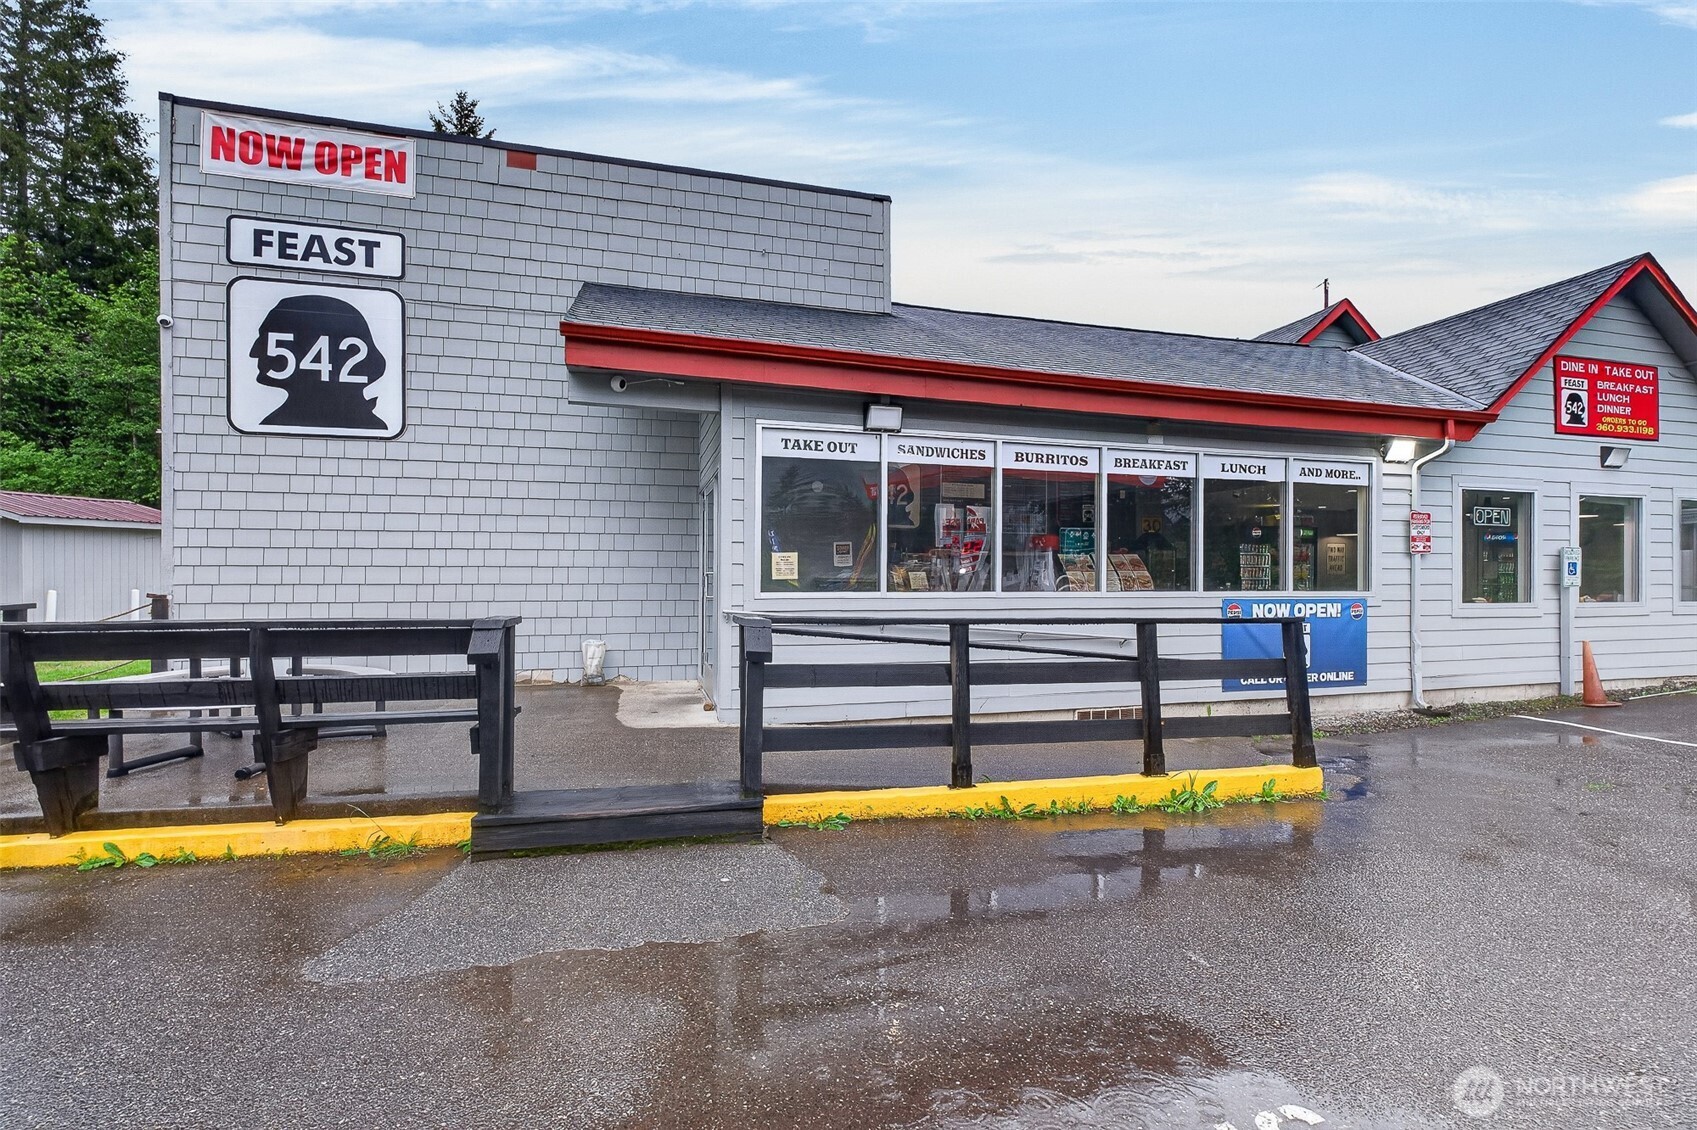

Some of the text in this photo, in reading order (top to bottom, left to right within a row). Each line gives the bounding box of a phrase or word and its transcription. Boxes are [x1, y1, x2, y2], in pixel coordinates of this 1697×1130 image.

[210, 125, 407, 184] NOW OPEN
[252, 228, 381, 268] FEAST
[266, 332, 369, 384] 542
[1560, 360, 1654, 381] DINE IN TAKE OUT
[1564, 379, 1585, 388] FEAST
[1597, 381, 1654, 395] BREAKFAST
[1597, 393, 1630, 404] LUNCH
[1566, 401, 1583, 415] 542
[1597, 404, 1632, 415] DINNER
[1602, 416, 1626, 424] ORDERS
[1596, 423, 1654, 435] 360.933.1198
[781, 438, 858, 454] TAKE OUT
[897, 444, 986, 460] SANDWICHES
[1014, 451, 1089, 467] BURRITOS
[1114, 457, 1188, 471] BREAKFAST
[1220, 463, 1267, 475] LUNCH
[1299, 467, 1323, 478] AND
[1475, 509, 1509, 525] OPEN
[1252, 603, 1341, 618] NOW OPEN!
[1320, 671, 1355, 681] ONLINE
